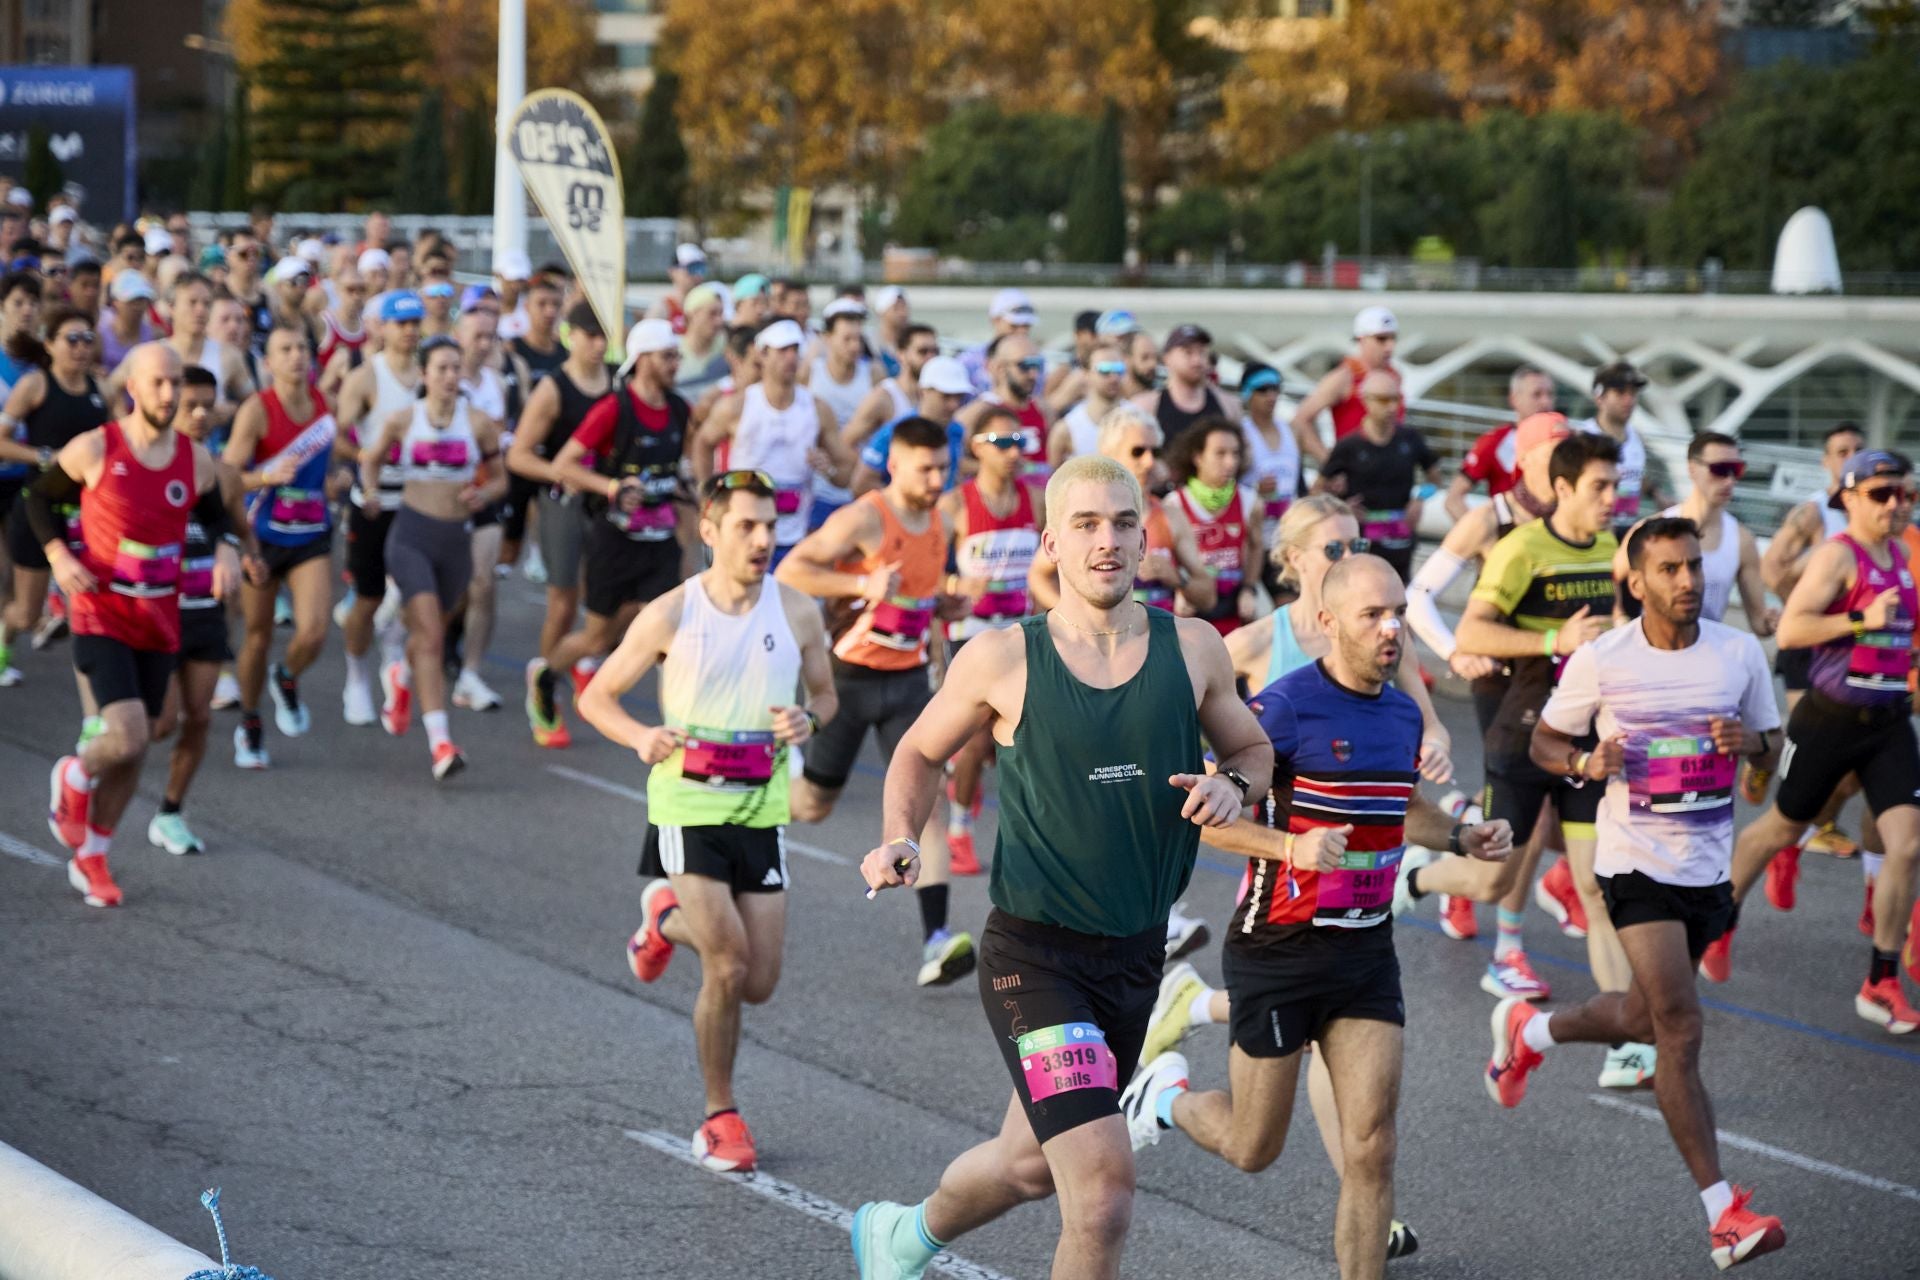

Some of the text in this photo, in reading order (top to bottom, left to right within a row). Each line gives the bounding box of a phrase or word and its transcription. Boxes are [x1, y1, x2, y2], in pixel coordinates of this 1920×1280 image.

[11, 80, 95, 105] ZURICH
[1088, 771, 1123, 780] RUNNING
[1094, 763, 1137, 774] PURESPORT
[992, 974, 1021, 991] team
[1042, 1047, 1097, 1073] 33919
[1054, 1071, 1092, 1091] Bails
